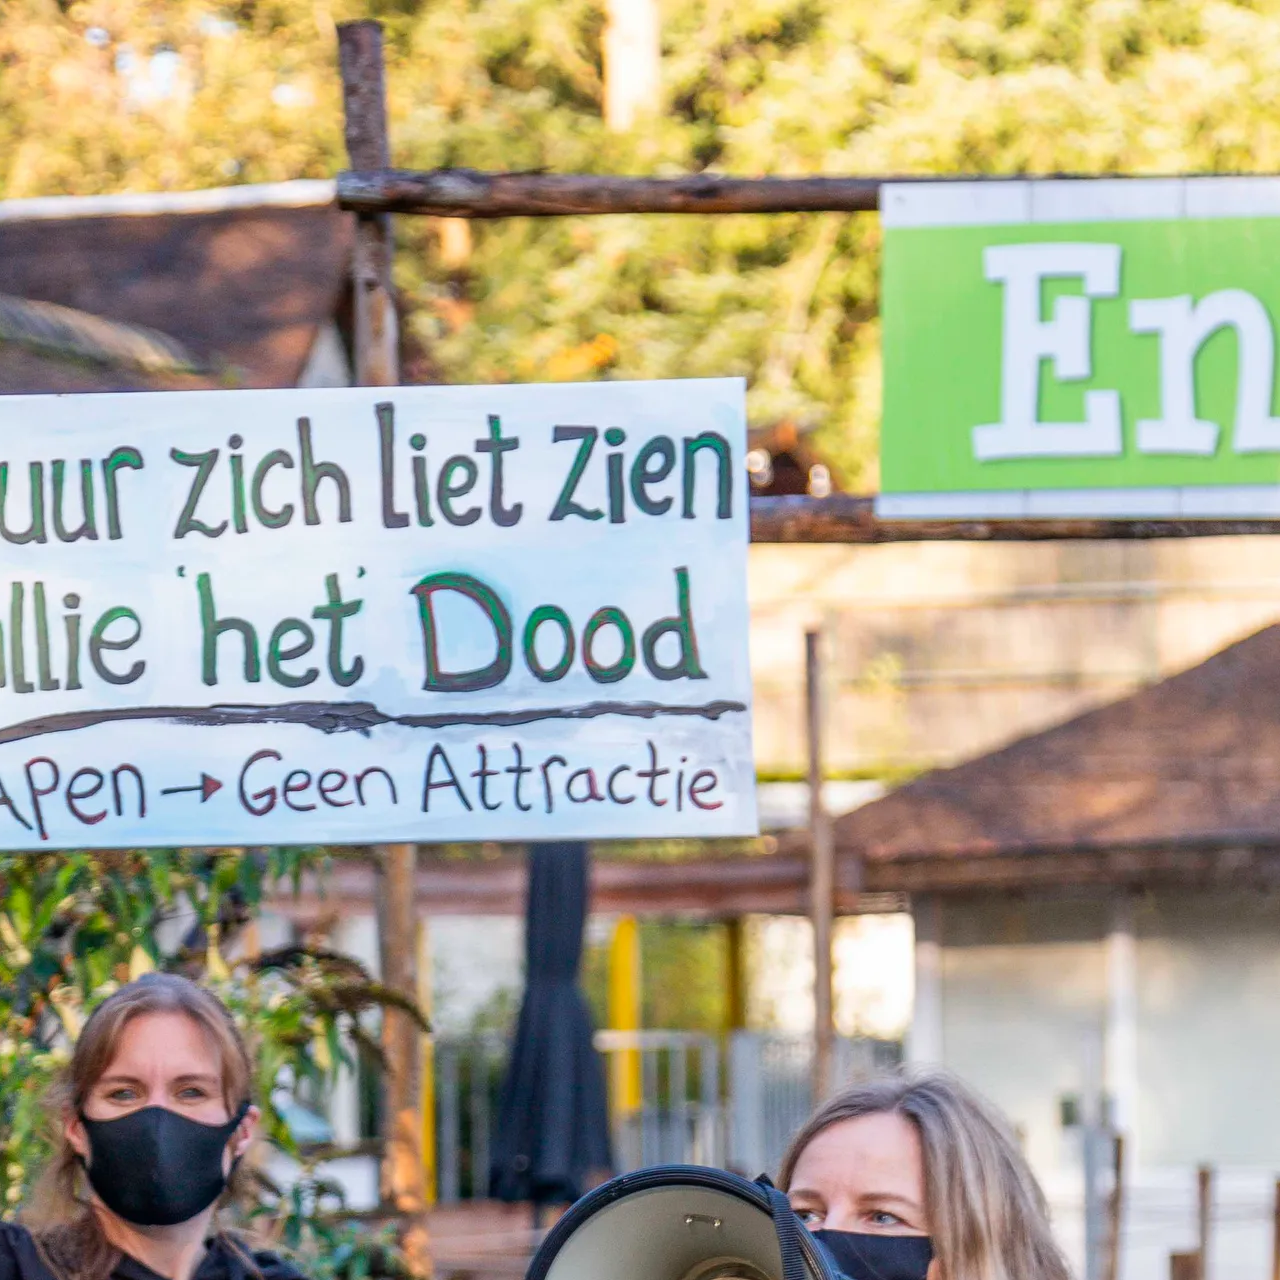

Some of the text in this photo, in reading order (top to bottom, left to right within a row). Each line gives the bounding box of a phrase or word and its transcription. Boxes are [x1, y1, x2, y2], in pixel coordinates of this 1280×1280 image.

[169, 417, 352, 540] zich
[374, 402, 523, 528] liet
[410, 565, 709, 693] Dood
[237, 748, 399, 816] Geen
[421, 739, 724, 815] Attractie
